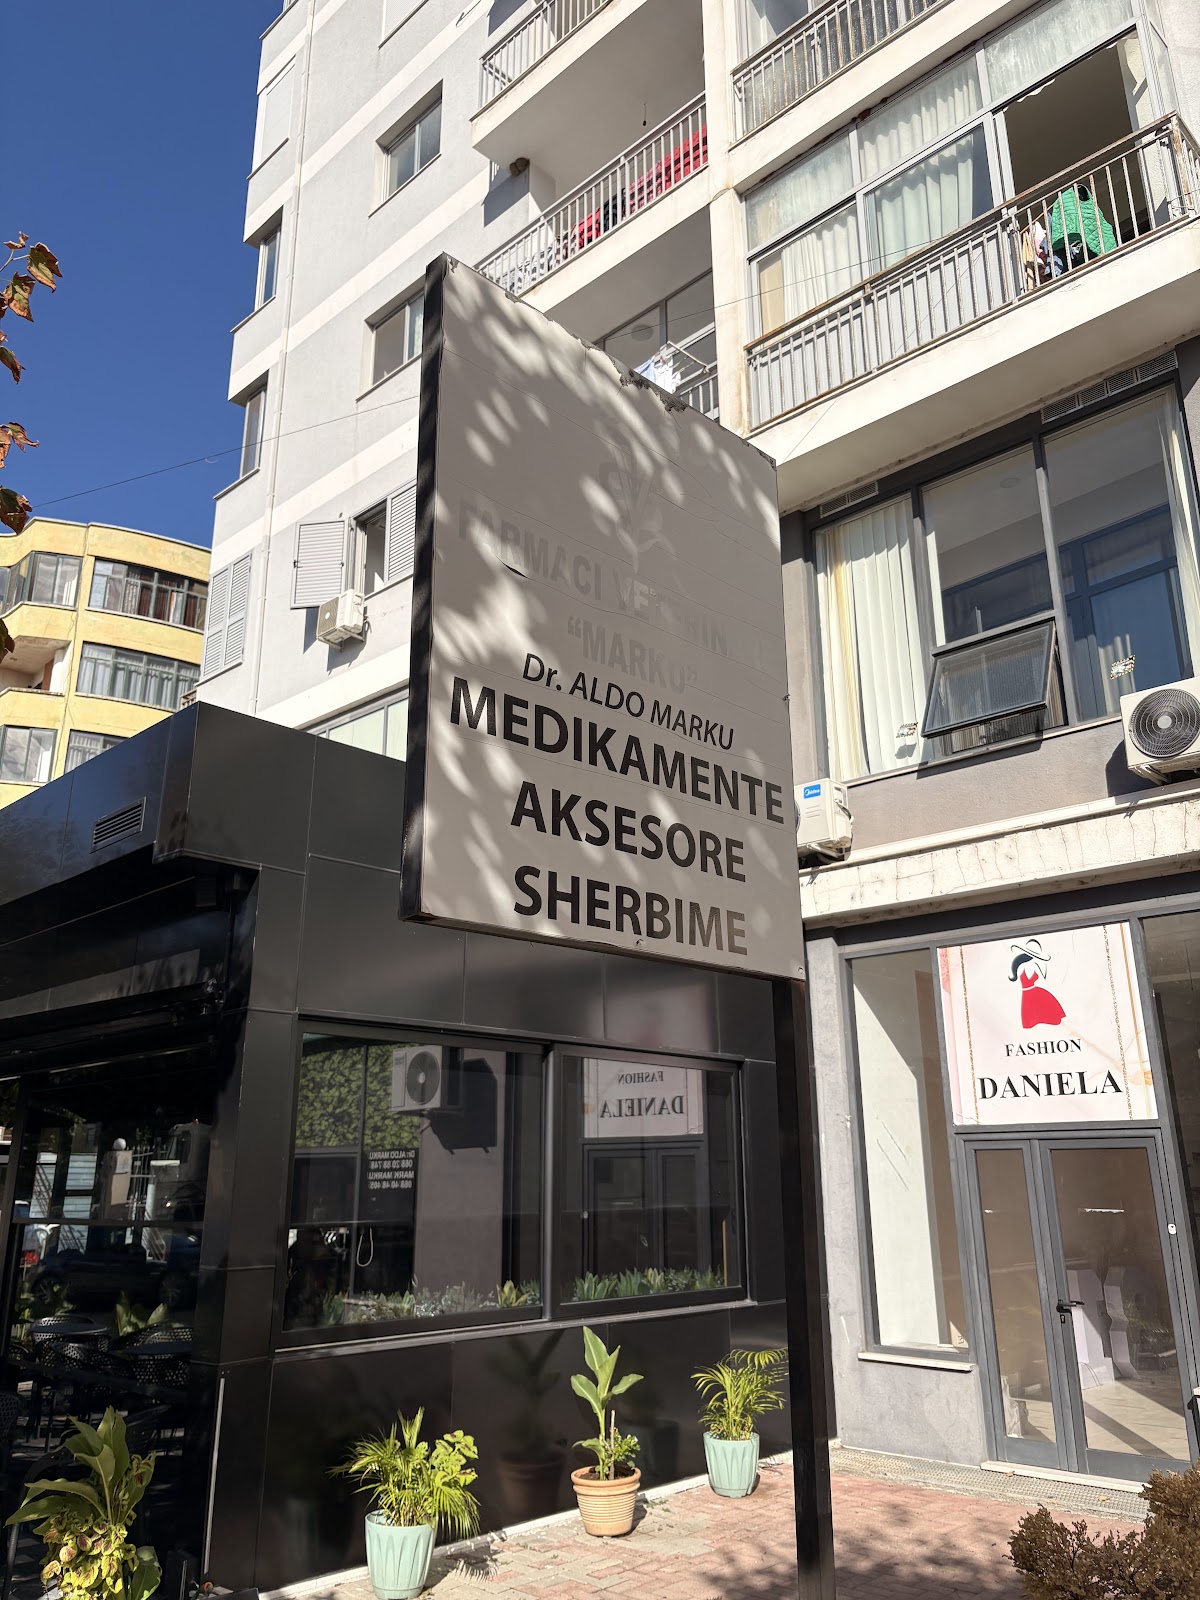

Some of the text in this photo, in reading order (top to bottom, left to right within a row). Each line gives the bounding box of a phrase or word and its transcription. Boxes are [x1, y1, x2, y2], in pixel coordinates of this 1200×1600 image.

[522, 652, 734, 751] Dr. ALDO MARKU
[450, 676, 785, 825] MEDIKAMENTE
[511, 780, 746, 883] AKSESORE
[513, 865, 748, 956] SHERBIME
[977, 1069, 1124, 1100] DANIELA
[1005, 1038, 1082, 1057] FASHION
